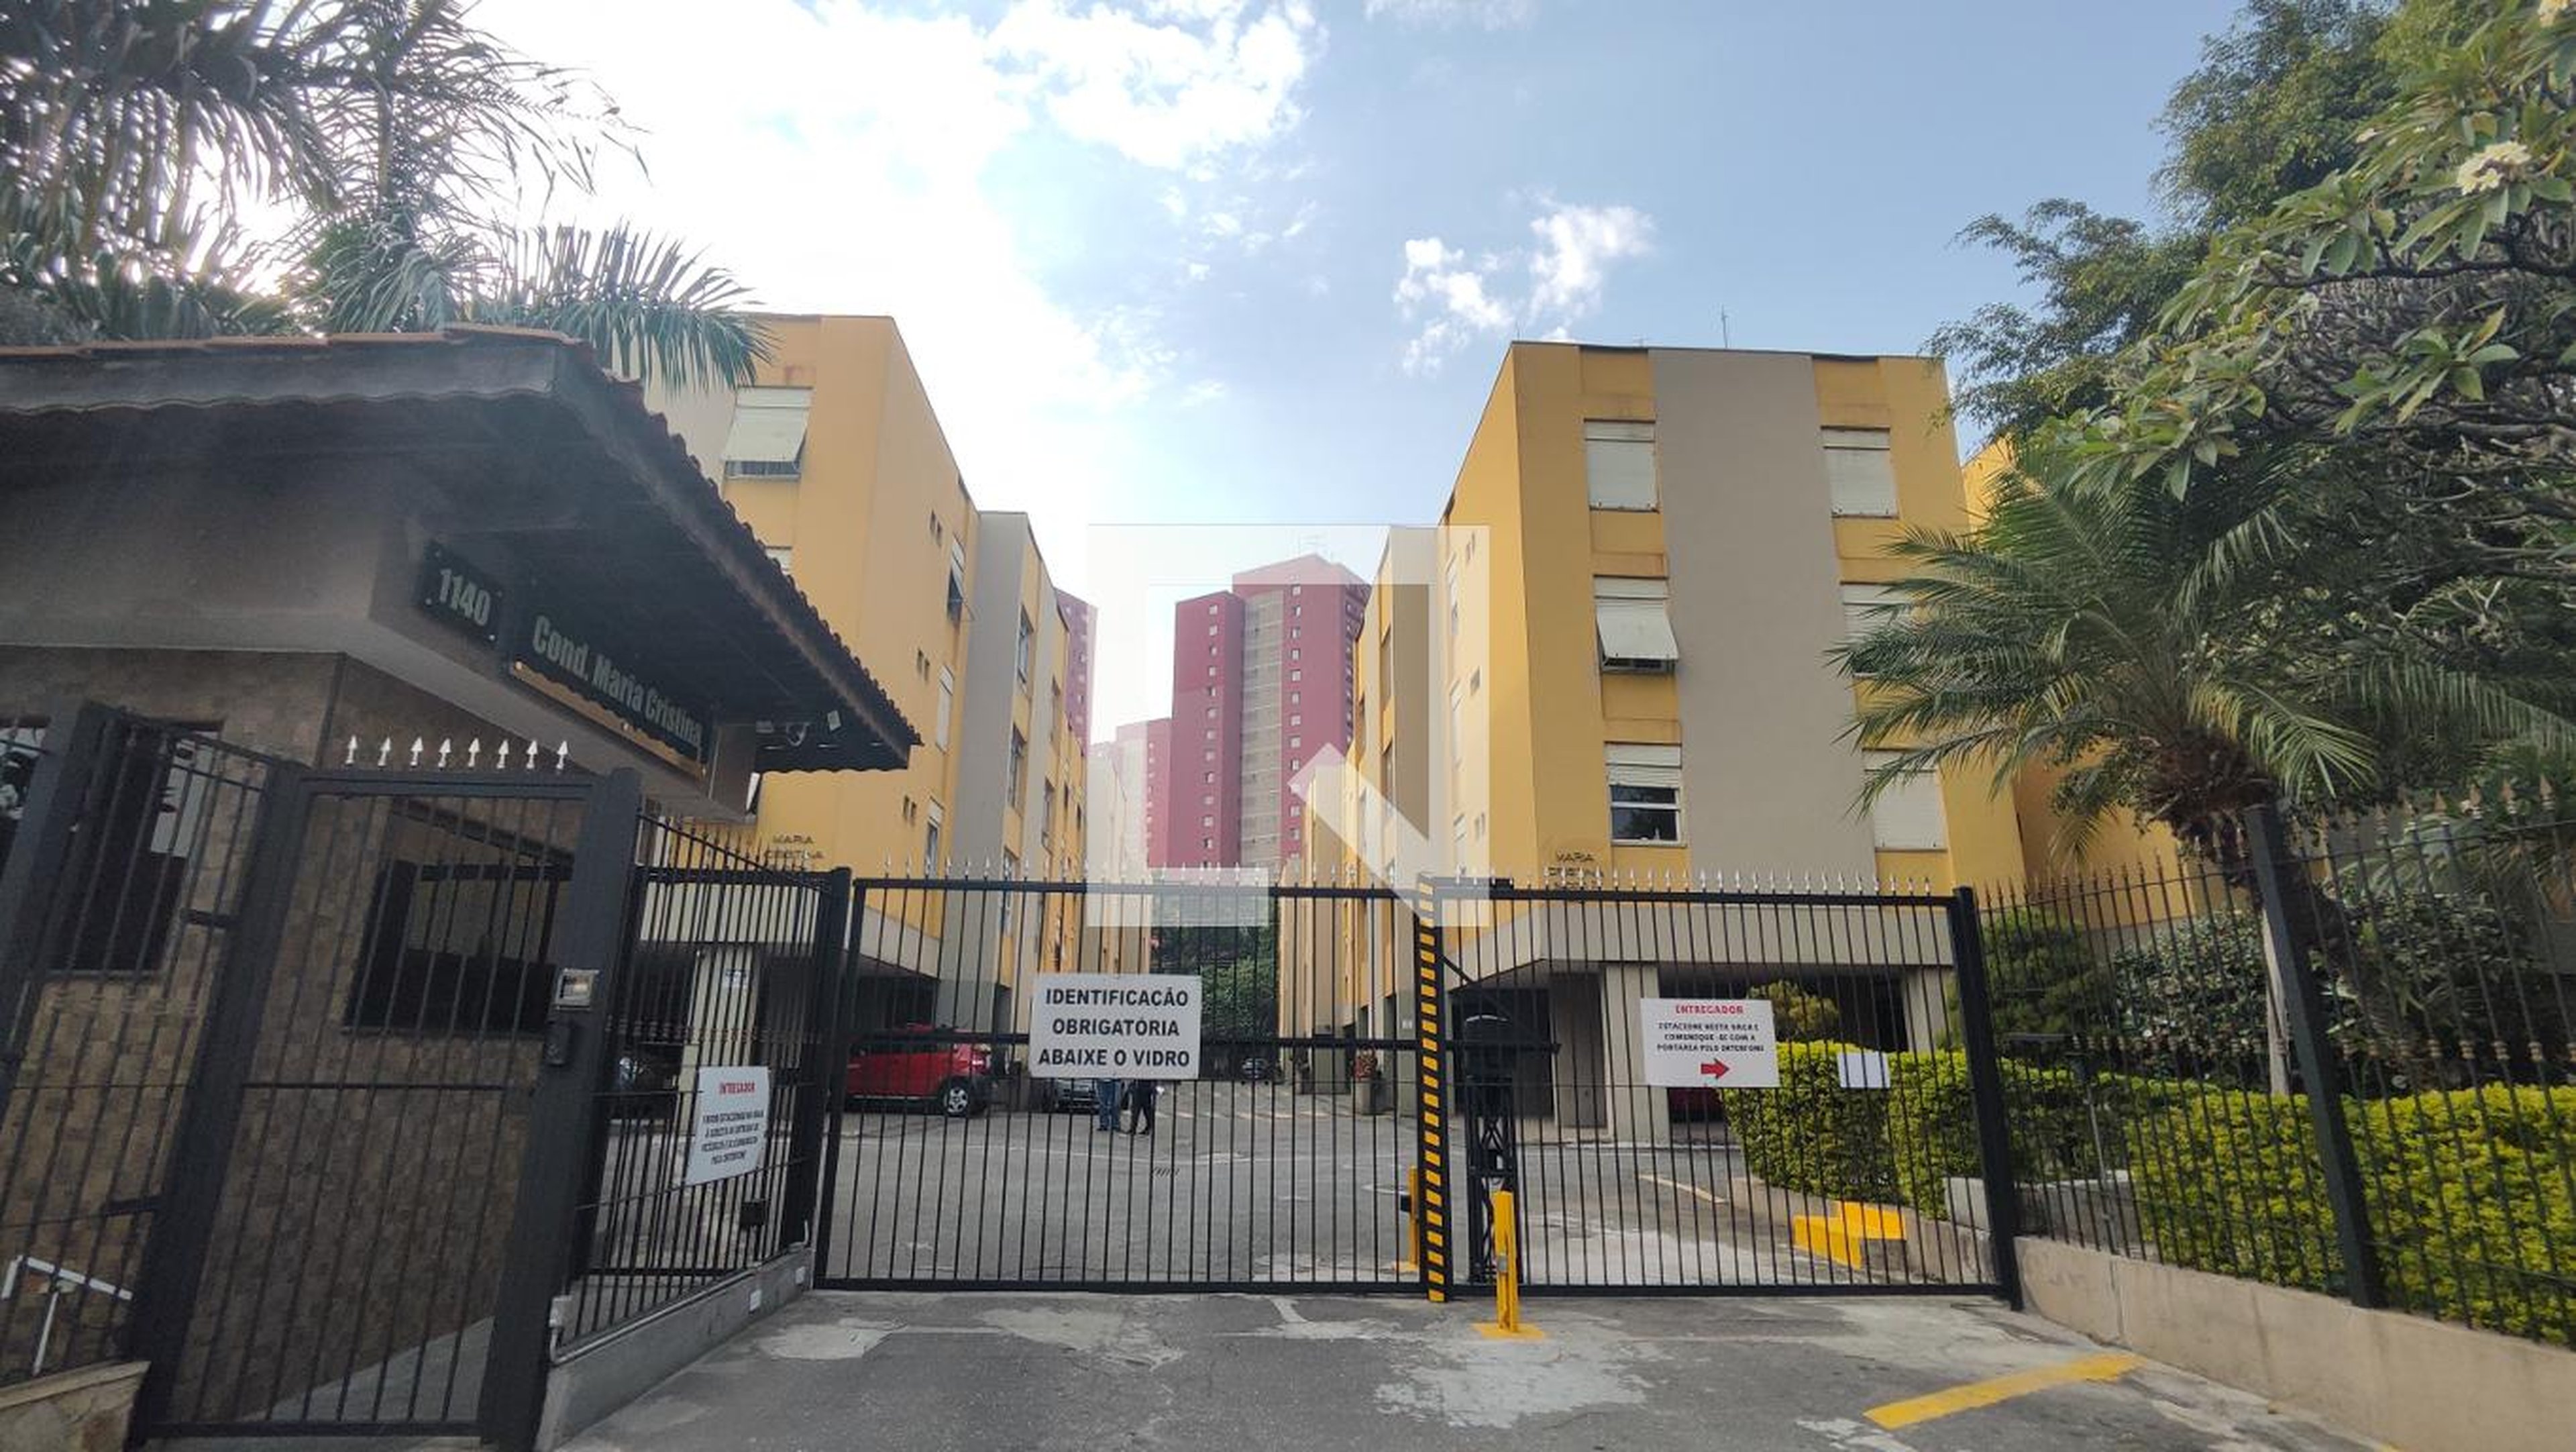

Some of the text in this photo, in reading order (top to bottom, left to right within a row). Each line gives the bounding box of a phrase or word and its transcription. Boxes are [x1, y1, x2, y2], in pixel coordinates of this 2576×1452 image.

[440, 568, 491, 625] 1140
[533, 615, 703, 747] Cond. Maria Cristina
[772, 835, 814, 844] MARA
[1556, 851, 1595, 862] MARA
[1045, 987, 1189, 1008] IDENTIFICAÇÃO
[1052, 1017, 1179, 1037] OBRIGATÓRIA
[1038, 1049, 1190, 1067] ABAIXE O VIDRO
